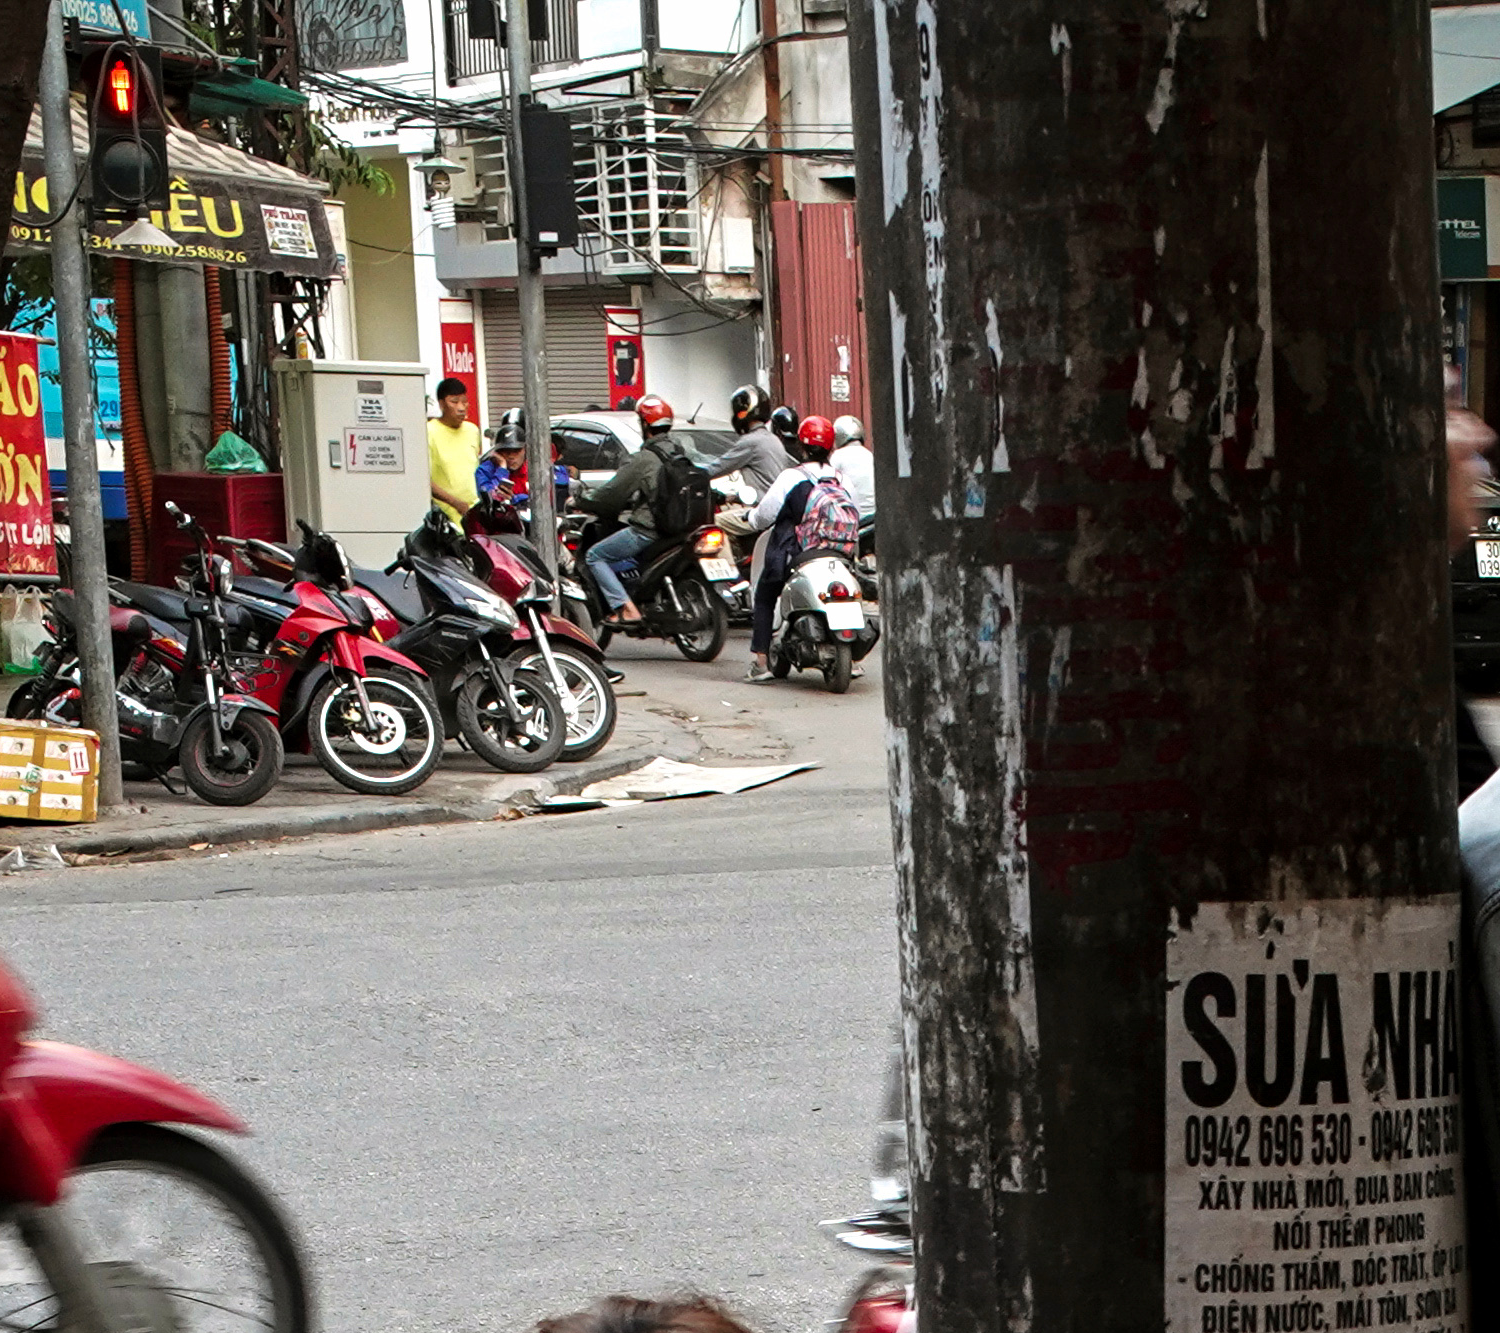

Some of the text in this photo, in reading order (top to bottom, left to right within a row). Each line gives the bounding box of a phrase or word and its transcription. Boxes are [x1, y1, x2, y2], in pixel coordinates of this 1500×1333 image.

[445, 342, 475, 373] Made
[1366, 939, 1461, 1101] NHÀ
[1184, 1113, 1251, 1167] 0942
[1257, 1112, 1303, 1166] 696
[1311, 1111, 1351, 1164] 530
[1371, 1108, 1414, 1162] 0942
[1198, 1174, 1246, 1211] XÂY
[1252, 1173, 1298, 1210] NHÀ
[1304, 1169, 1349, 1210] MỚI,
[1317, 1212, 1370, 1249] THÊM
[1194, 1253, 1275, 1294] CHỐNG
[1263, 1294, 1331, 1333] NƯỚC,
[1335, 1293, 1373, 1330] MÁI
